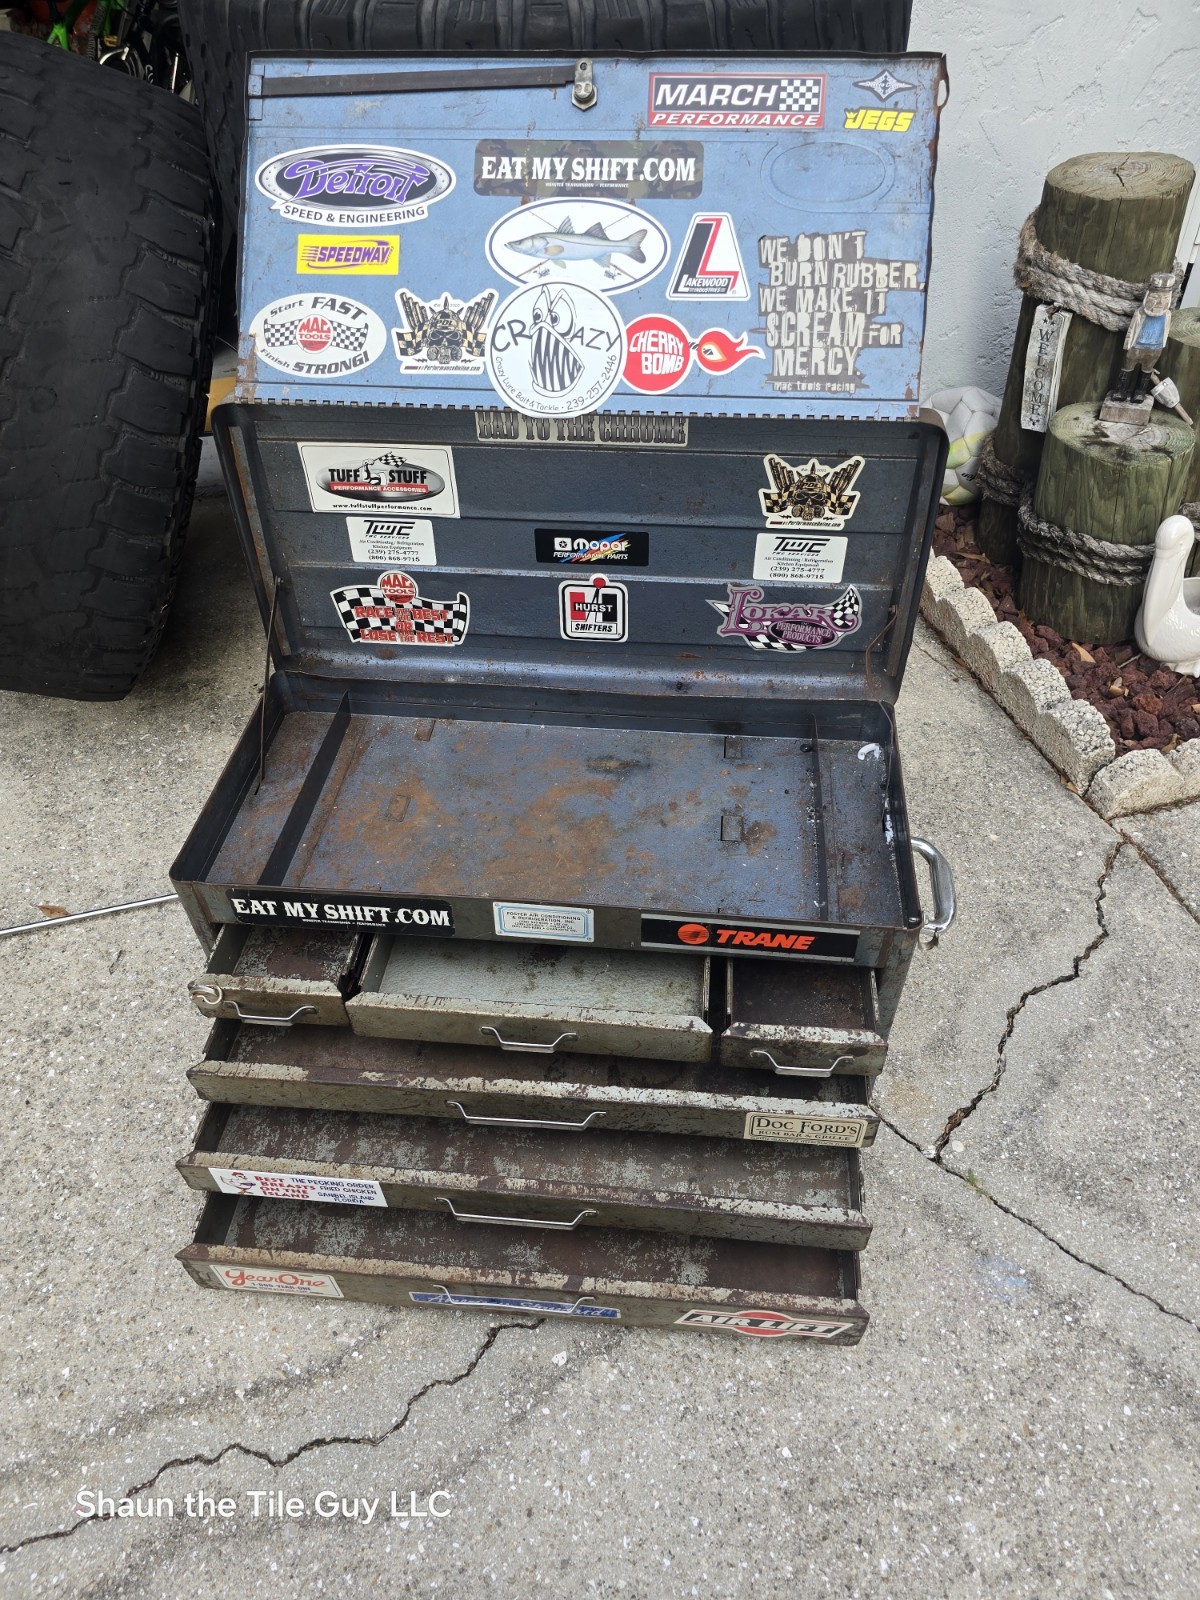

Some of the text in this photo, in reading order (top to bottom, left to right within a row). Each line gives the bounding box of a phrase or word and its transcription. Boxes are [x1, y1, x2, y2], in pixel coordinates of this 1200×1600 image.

[655, 84, 778, 107] MARCH
[652, 113, 821, 126] PERFORMANCE
[844, 108, 915, 132] JEGS
[481, 157, 527, 180] EAT
[532, 157, 569, 180] MY
[284, 204, 425, 224] SPEED & ENGINEERING
[317, 246, 390, 263] SPEEDWAY
[760, 231, 866, 264] WE DON'T
[678, 274, 728, 293] LAKEWOOD
[769, 261, 925, 291] BURN RUBBER,
[270, 296, 367, 321] Start FAST
[759, 286, 889, 315] WE MAKE IT
[298, 317, 331, 333] MAC
[766, 311, 901, 348] SCREAM FOR
[298, 333, 331, 341] TOOLS
[629, 330, 684, 356] CHERRY
[260, 348, 370, 375] Finish STRONG!
[641, 353, 684, 375] BOMB
[773, 347, 861, 377] MERCY.
[1030, 328, 1055, 417] WELCOME
[495, 356, 505, 378] Crazy
[502, 376, 516, 395] Lure
[515, 390, 530, 407] Bait
[535, 401, 560, 412] Tackle
[566, 354, 617, 411] 239-257-2446
[825, 382, 855, 394] racing
[328, 468, 427, 484] TUFF STUFF
[363, 519, 415, 536] TWC
[774, 536, 830, 553] TWC
[381, 574, 413, 589] MAC
[354, 606, 393, 619] RACE
[411, 609, 450, 622] BEST
[575, 603, 613, 612] HURST
[395, 620, 413, 632] OR
[575, 623, 613, 633] SHIFTERS
[776, 622, 832, 637] PERFORMANCE
[360, 629, 397, 642] LOSE
[416, 632, 453, 644] REST
[782, 630, 822, 643] PRODUCTS
[231, 898, 278, 916] EAT
[283, 901, 319, 918] MY
[716, 929, 816, 950] TRANE
[254, 1175, 285, 1183] BEST
[260, 1181, 316, 1191] BREASTS
[307, 1179, 345, 1187] PECKING
[347, 1182, 375, 1190] ORDER
[262, 1190, 310, 1199] ISLAND
[282, 1187, 308, 1195] THE
[318, 1191, 346, 1199] SANIBEL
[343, 1187, 377, 1196] CHICKEN
[690, 1314, 835, 1333] AIR LIFT
